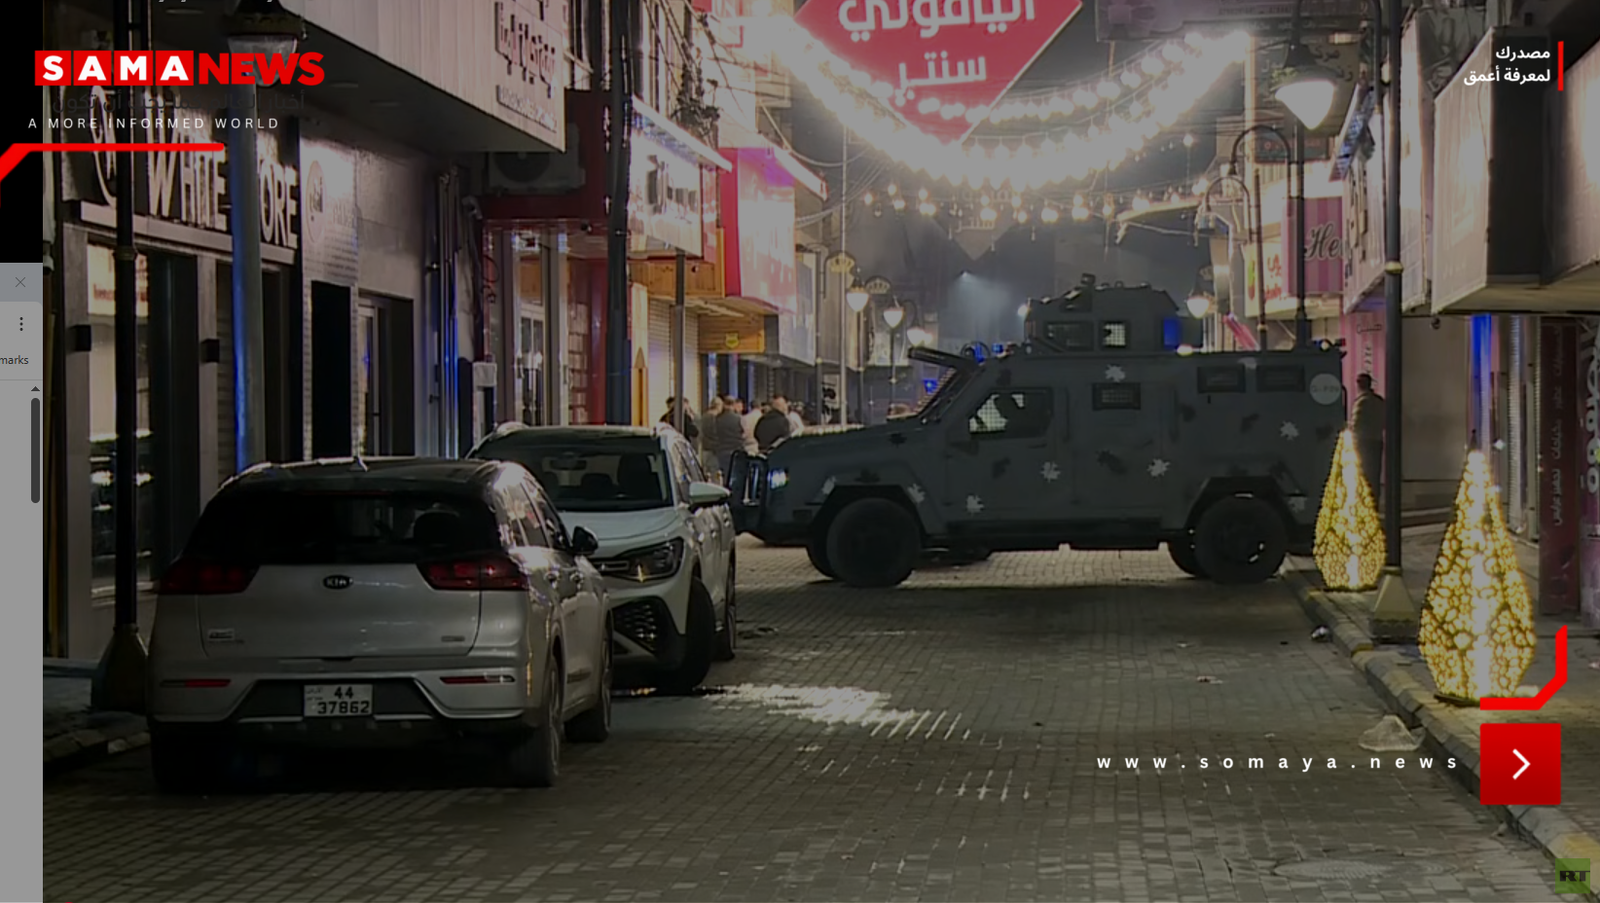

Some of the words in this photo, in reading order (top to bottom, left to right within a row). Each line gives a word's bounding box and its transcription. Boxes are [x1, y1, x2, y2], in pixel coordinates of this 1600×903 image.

[326, 578, 347, 587] KIA
[334, 686, 354, 699] 44
[317, 700, 370, 714] 37862
